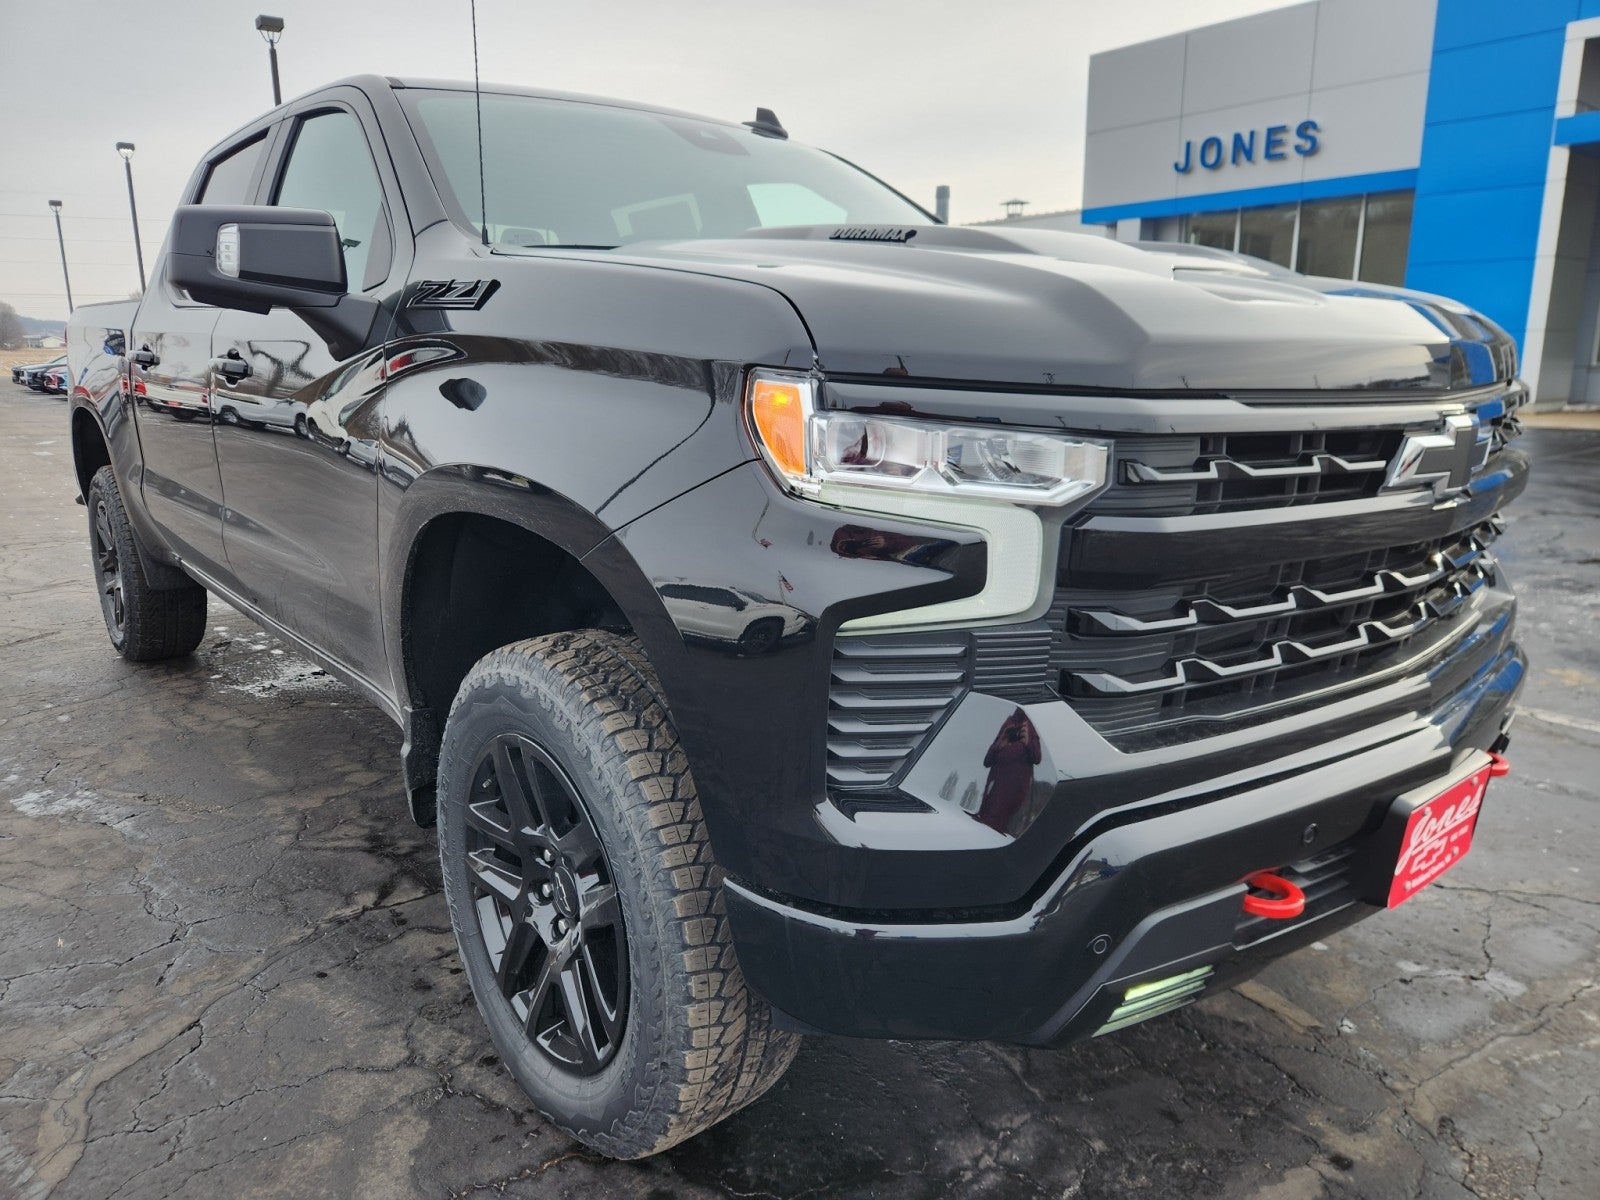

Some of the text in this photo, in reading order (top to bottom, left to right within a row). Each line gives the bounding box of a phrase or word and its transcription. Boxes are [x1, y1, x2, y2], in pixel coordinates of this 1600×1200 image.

[1174, 120, 1319, 174] JONES
[829, 227, 917, 243] DURAMAX
[406, 279, 500, 310] Z71
[1394, 784, 1485, 876] Jones
